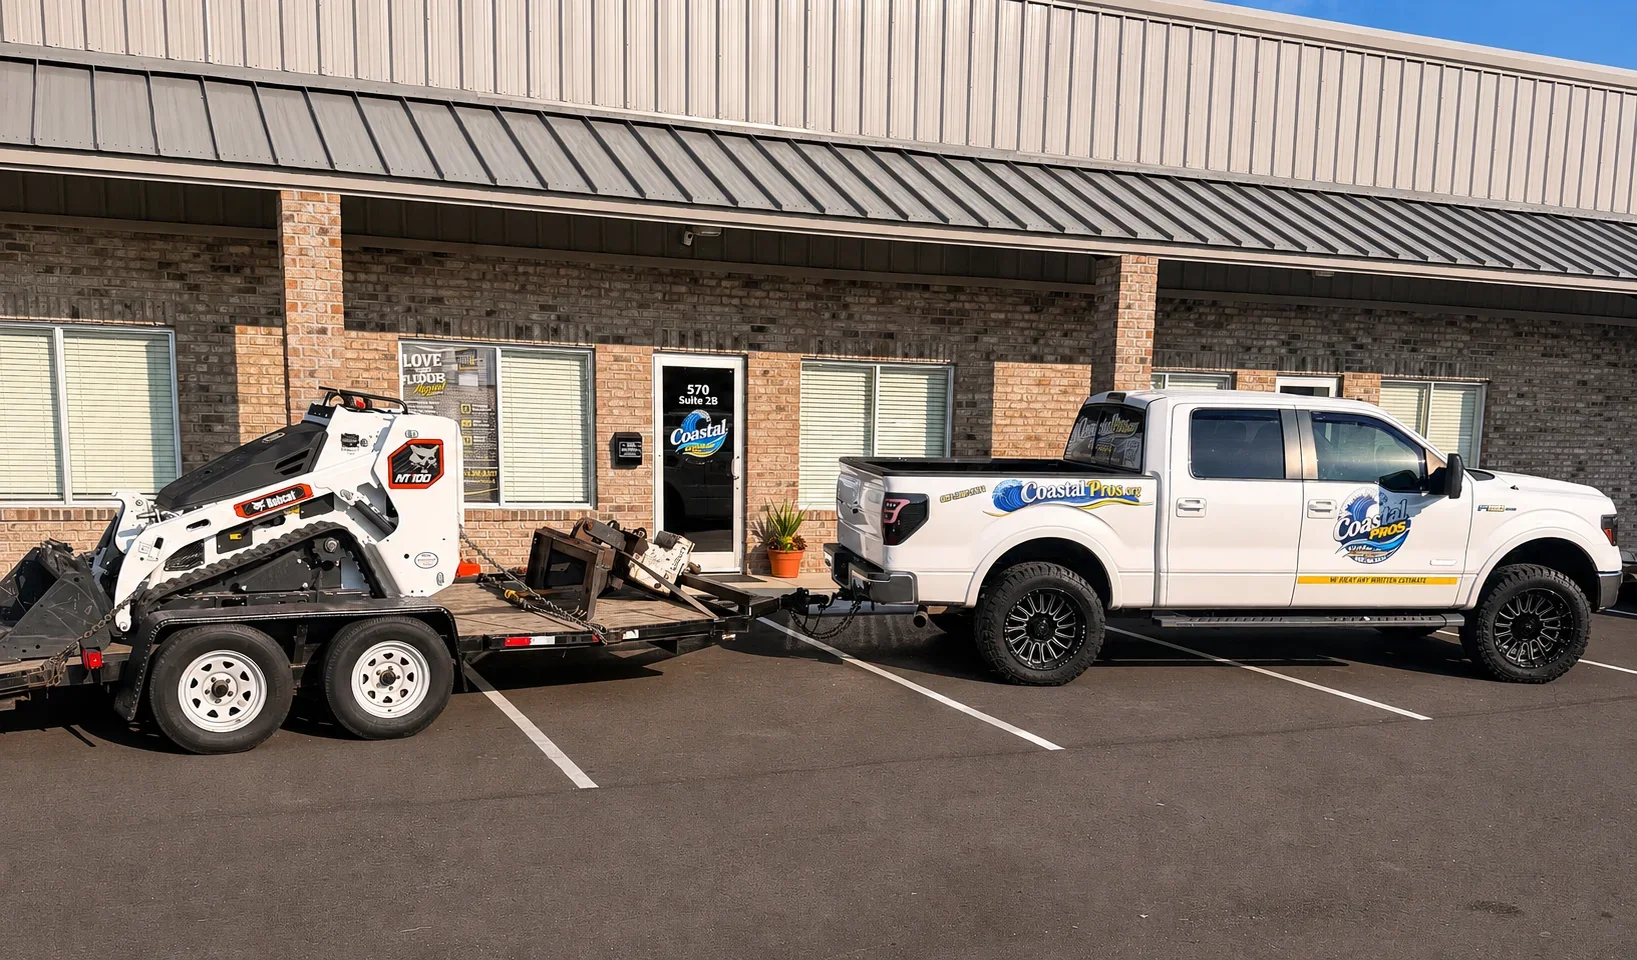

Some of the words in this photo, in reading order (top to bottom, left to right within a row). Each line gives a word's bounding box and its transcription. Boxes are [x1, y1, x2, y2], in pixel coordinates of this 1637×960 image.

[403, 353, 442, 367] LOVE
[687, 384, 710, 395] 570
[679, 396, 703, 405] Suite
[705, 397, 718, 405] 2B
[670, 419, 727, 445] Coastal
[266, 490, 297, 508] Bobcat
[1333, 499, 1409, 542] Coastal
[1368, 521, 1406, 540] PROS
